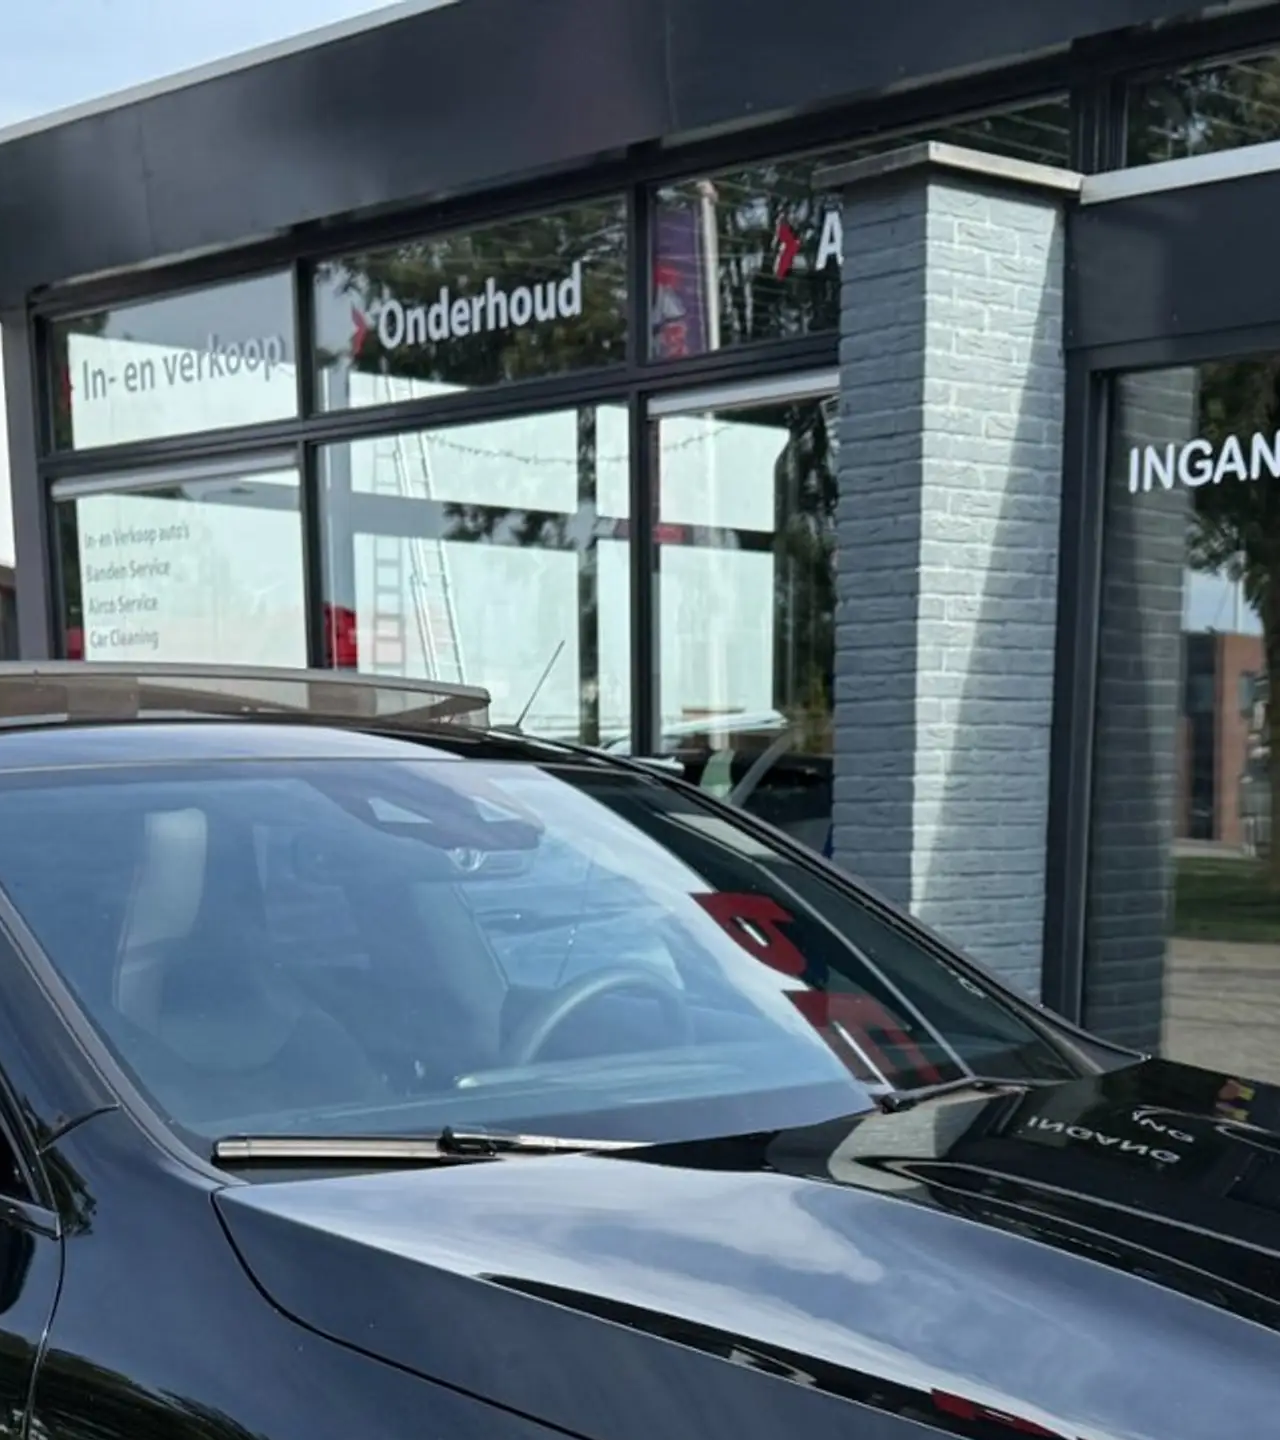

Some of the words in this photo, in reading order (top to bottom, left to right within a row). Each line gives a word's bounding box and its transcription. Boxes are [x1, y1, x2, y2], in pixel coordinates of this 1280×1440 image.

[378, 259, 583, 350] Onderhoud
[82, 360, 117, 401] In-
[124, 357, 155, 393] en
[163, 332, 286, 382] verkoop
[129, 557, 171, 580] Service
[118, 592, 158, 613] Service
[89, 630, 108, 650] Car
[110, 627, 159, 651] Cleaning
